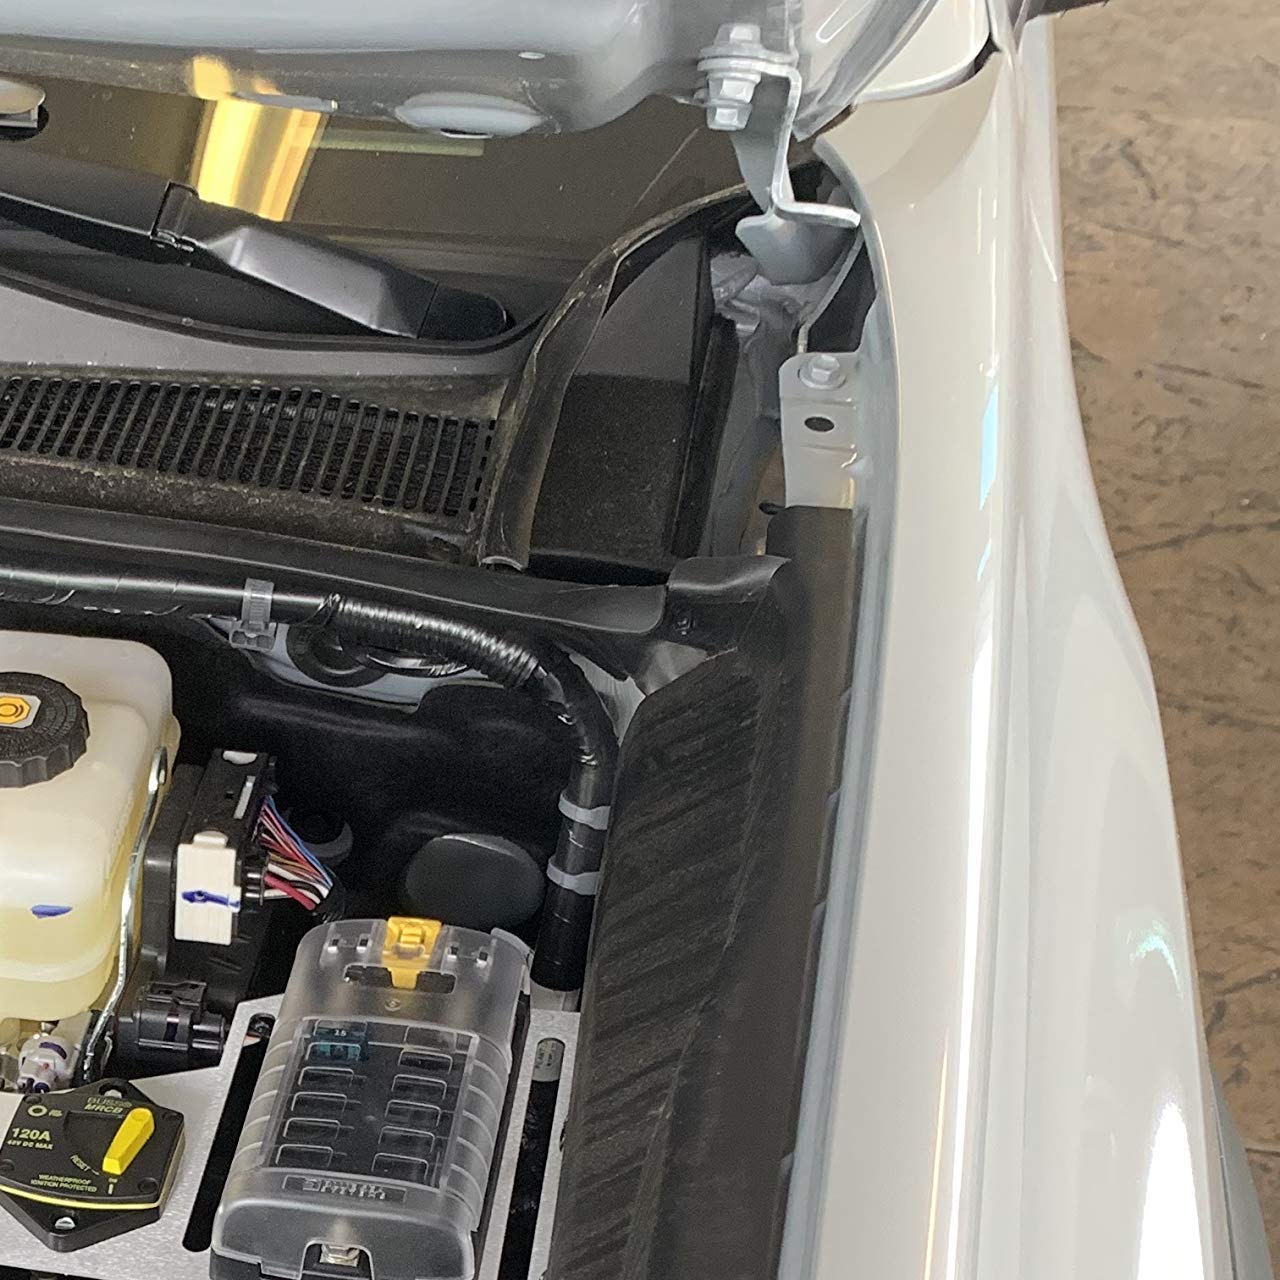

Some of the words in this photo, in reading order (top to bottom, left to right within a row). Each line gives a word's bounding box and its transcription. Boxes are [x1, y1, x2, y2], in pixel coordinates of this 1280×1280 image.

[12, 1128, 51, 1142] 120A
[35, 1142, 53, 1150] MAX
[39, 1174, 92, 1185] WEATHERPROOF
[30, 1179, 55, 1188] IGNITION
[60, 1182, 97, 1193] PROTECTED
